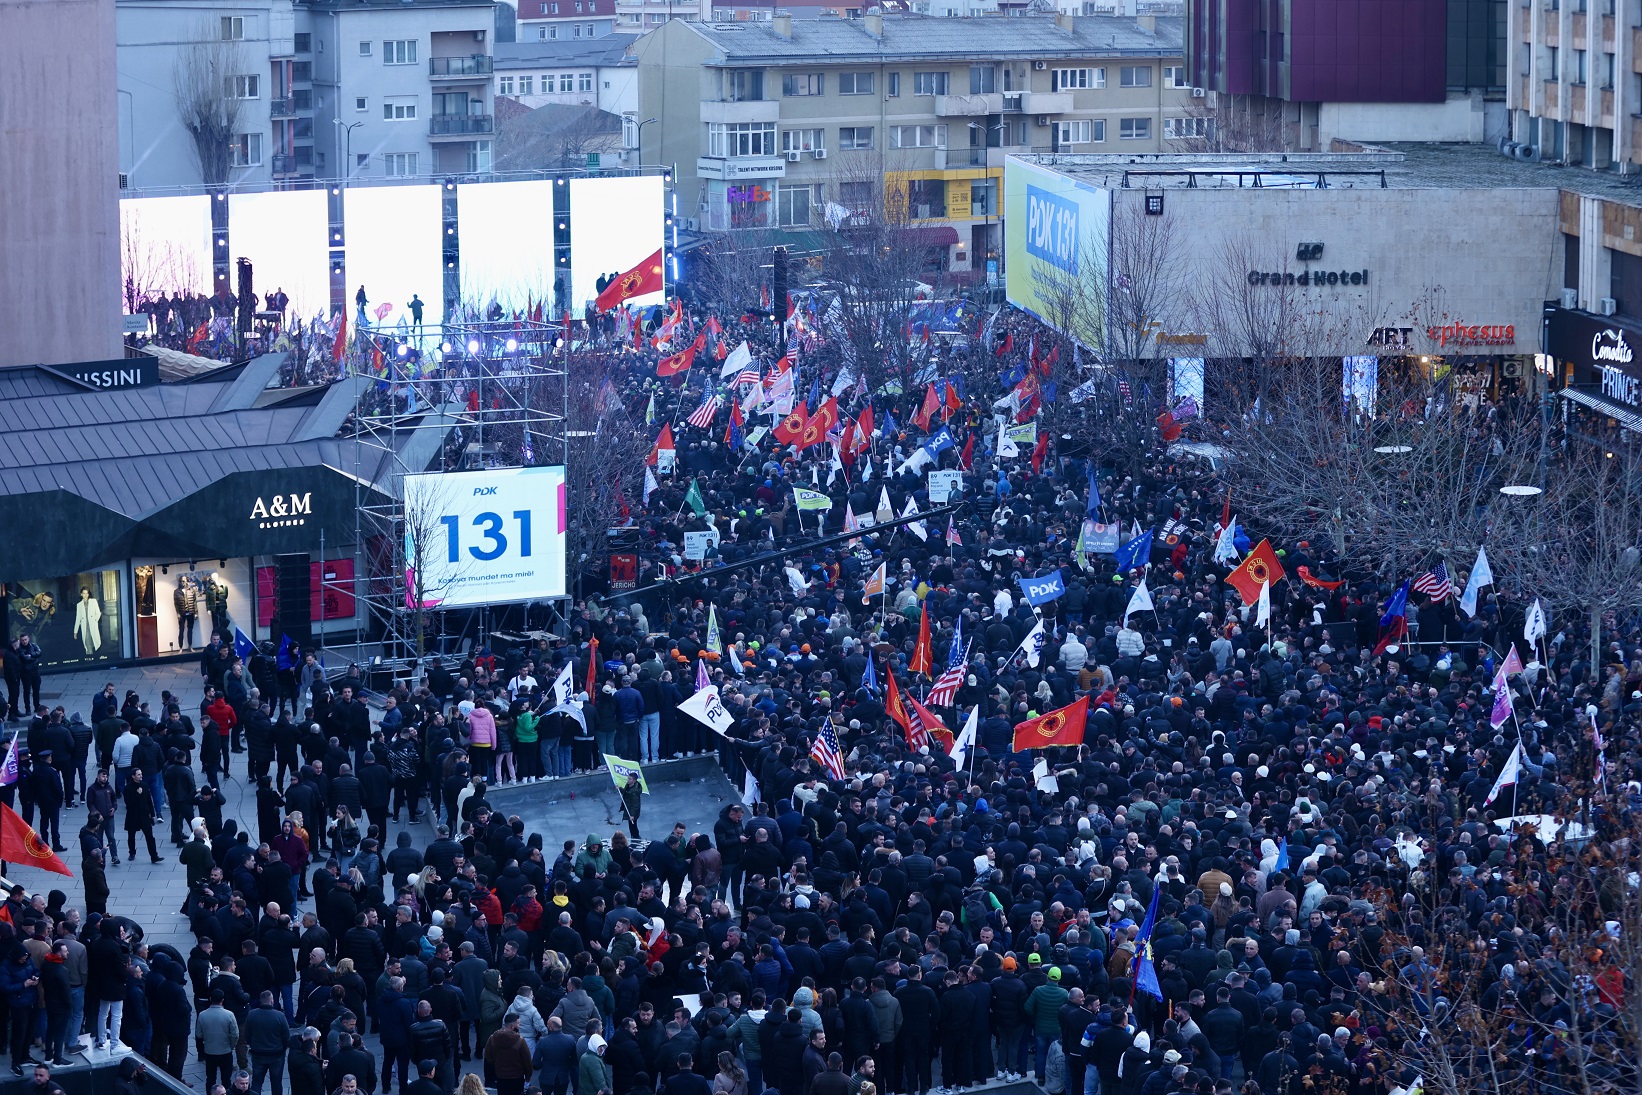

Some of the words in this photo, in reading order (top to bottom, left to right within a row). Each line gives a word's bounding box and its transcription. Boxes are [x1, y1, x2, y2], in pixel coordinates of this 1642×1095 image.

[727, 185, 771, 203] FedEx
[1028, 194, 1055, 253] PDK
[1056, 206, 1077, 263] 131
[1248, 270, 1309, 286] Grand
[1314, 269, 1368, 286] Hotel
[1365, 327, 1413, 346] ART
[1429, 321, 1515, 348] ephesus
[1592, 328, 1633, 363] Comodita
[1601, 368, 1639, 407] PRINCE
[473, 487, 497, 496] PDK
[250, 492, 312, 519] A&M
[260, 519, 305, 529] CLOTHES
[440, 509, 532, 563] 131
[438, 575, 467, 585] Kosova
[469, 573, 499, 582] mundet
[515, 570, 534, 578] mirë!
[611, 581, 636, 589] JERICHO
[1029, 580, 1060, 597] PDK
